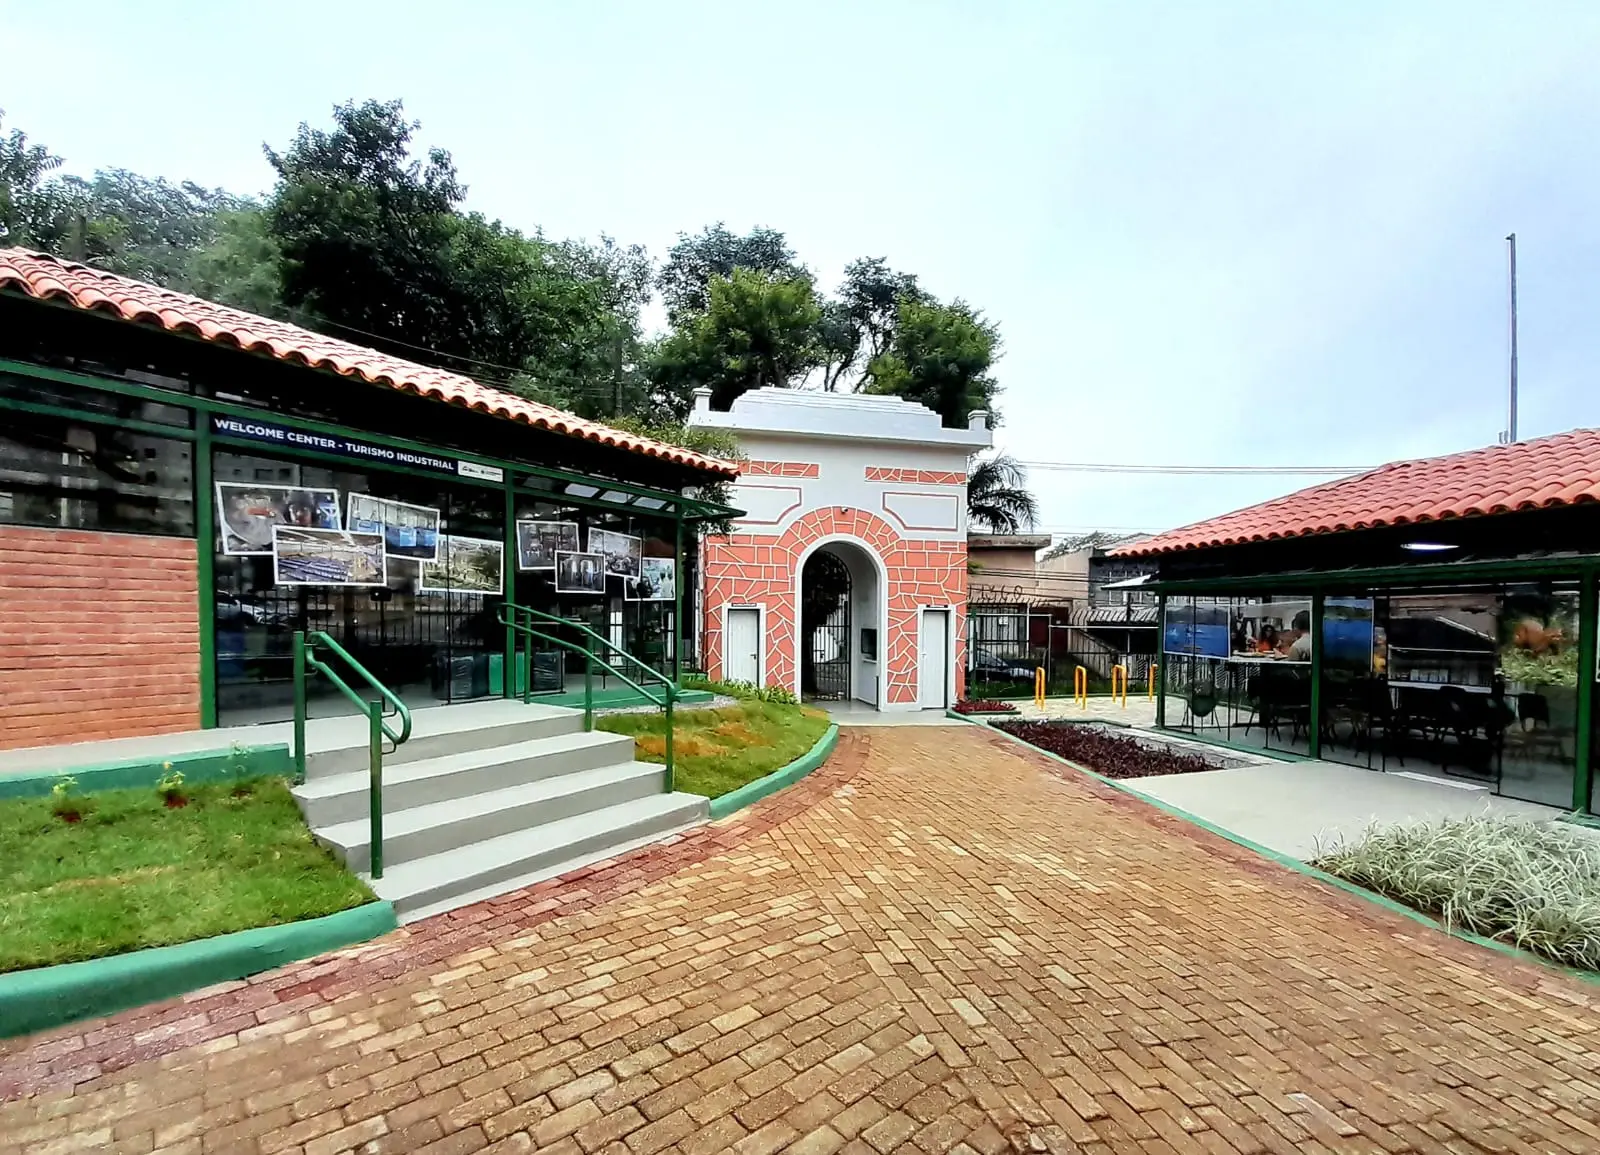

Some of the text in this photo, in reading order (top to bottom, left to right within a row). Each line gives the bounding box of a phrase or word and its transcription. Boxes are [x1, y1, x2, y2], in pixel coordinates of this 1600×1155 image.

[214, 418, 284, 439] WELCOME
[287, 432, 335, 448] CENTER
[345, 442, 394, 458] TURISMO
[397, 452, 454, 470] INDUSTRIAL
